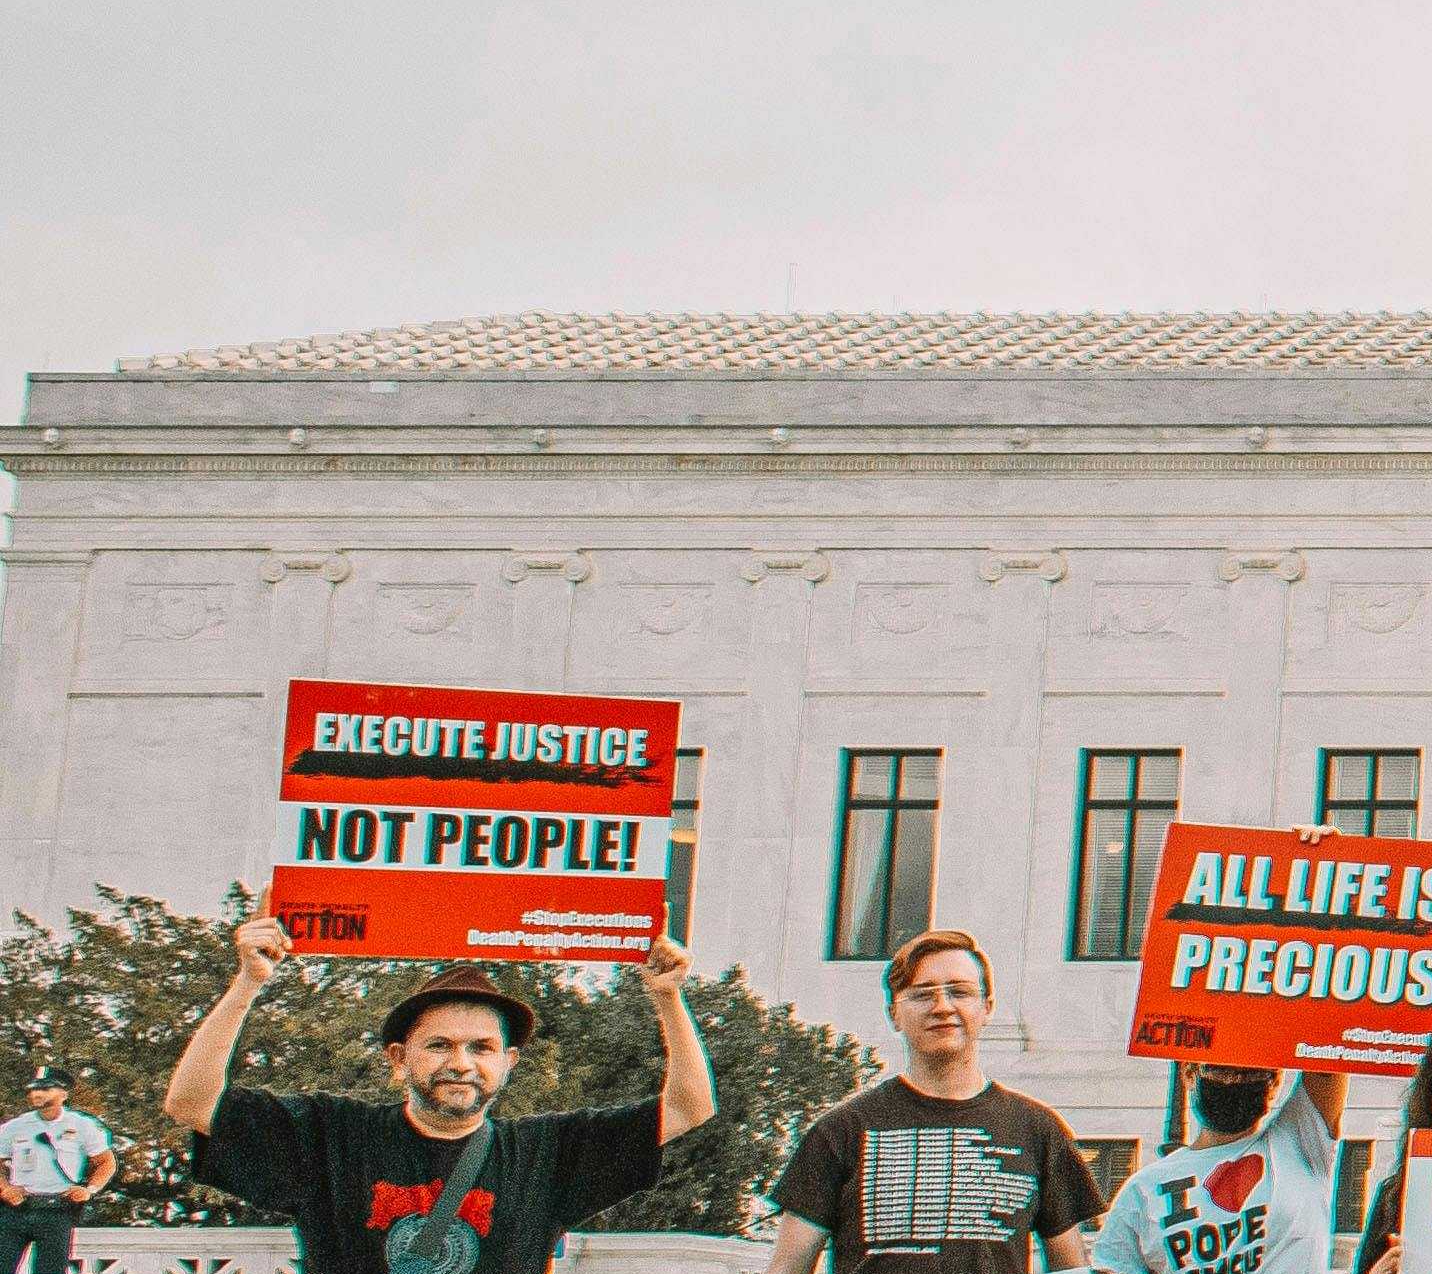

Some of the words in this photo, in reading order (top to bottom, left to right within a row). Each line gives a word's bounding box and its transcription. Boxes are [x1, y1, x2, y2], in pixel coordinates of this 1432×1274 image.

[313, 712, 485, 760] EXECUTE
[492, 722, 648, 768] JUSTICE
[298, 807, 415, 864] NOT
[424, 812, 641, 872] PEOPLE!
[1182, 852, 1275, 910] ALL
[1283, 859, 1392, 917] LIFE
[1157, 1175, 1200, 1228] I
[1164, 1204, 1269, 1272] POPE
